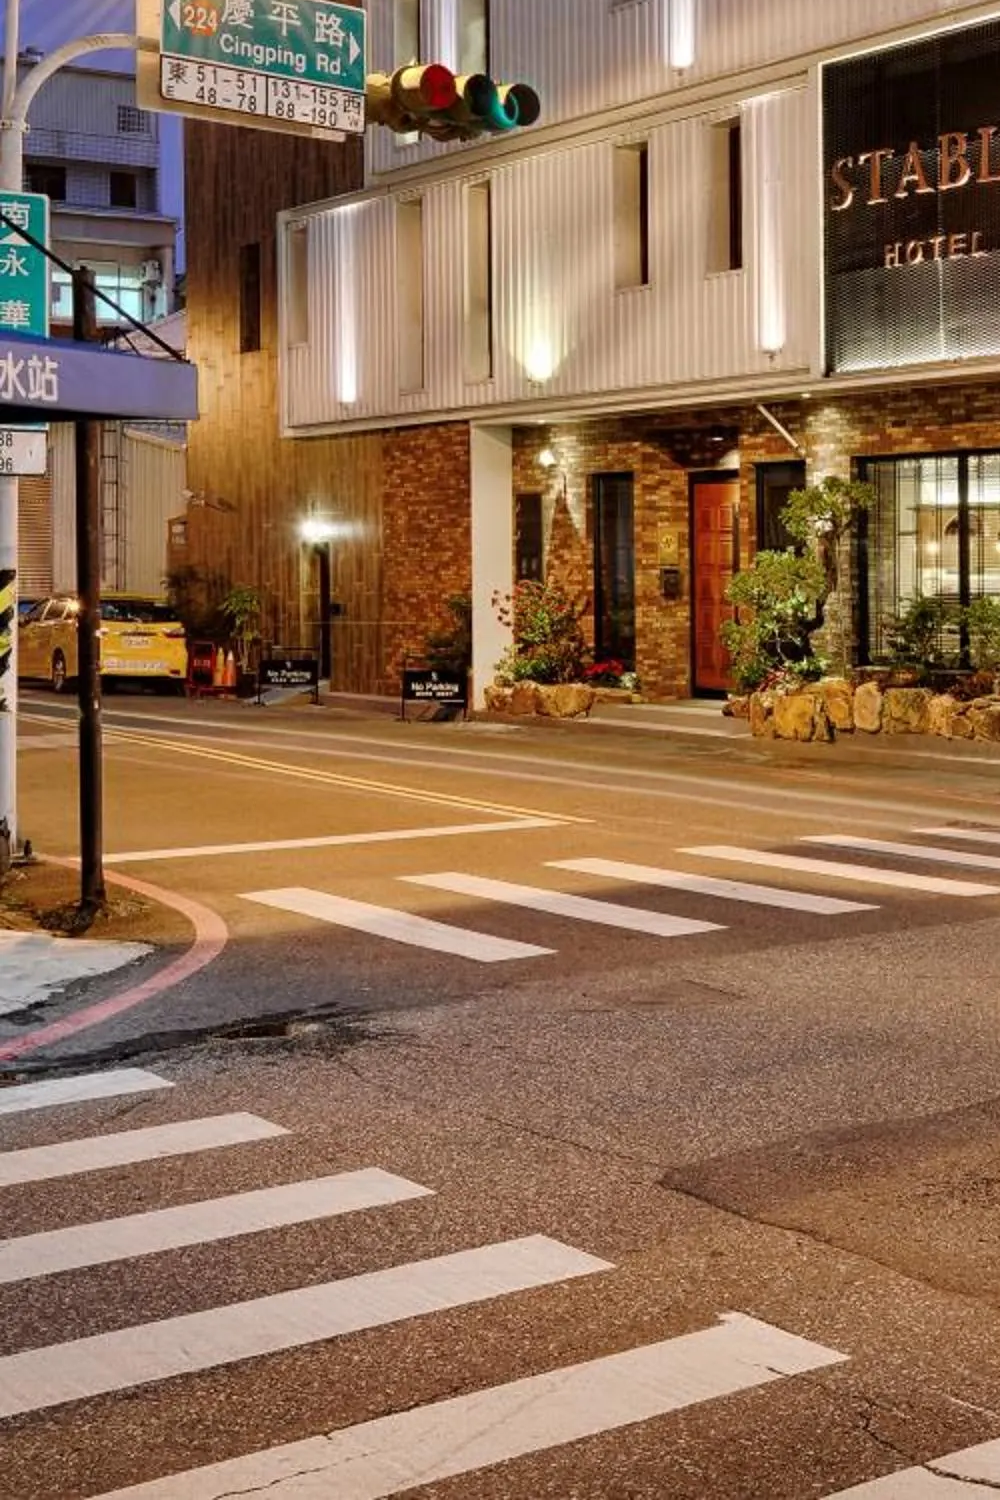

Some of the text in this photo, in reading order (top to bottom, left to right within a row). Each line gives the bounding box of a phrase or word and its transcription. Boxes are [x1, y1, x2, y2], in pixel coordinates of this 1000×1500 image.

[183, 5, 218, 33] 224
[220, 33, 347, 77] Cingping Rd.
[167, 61, 189, 84] 東
[0, 201, 30, 230] 南
[884, 231, 988, 269] HOTEL
